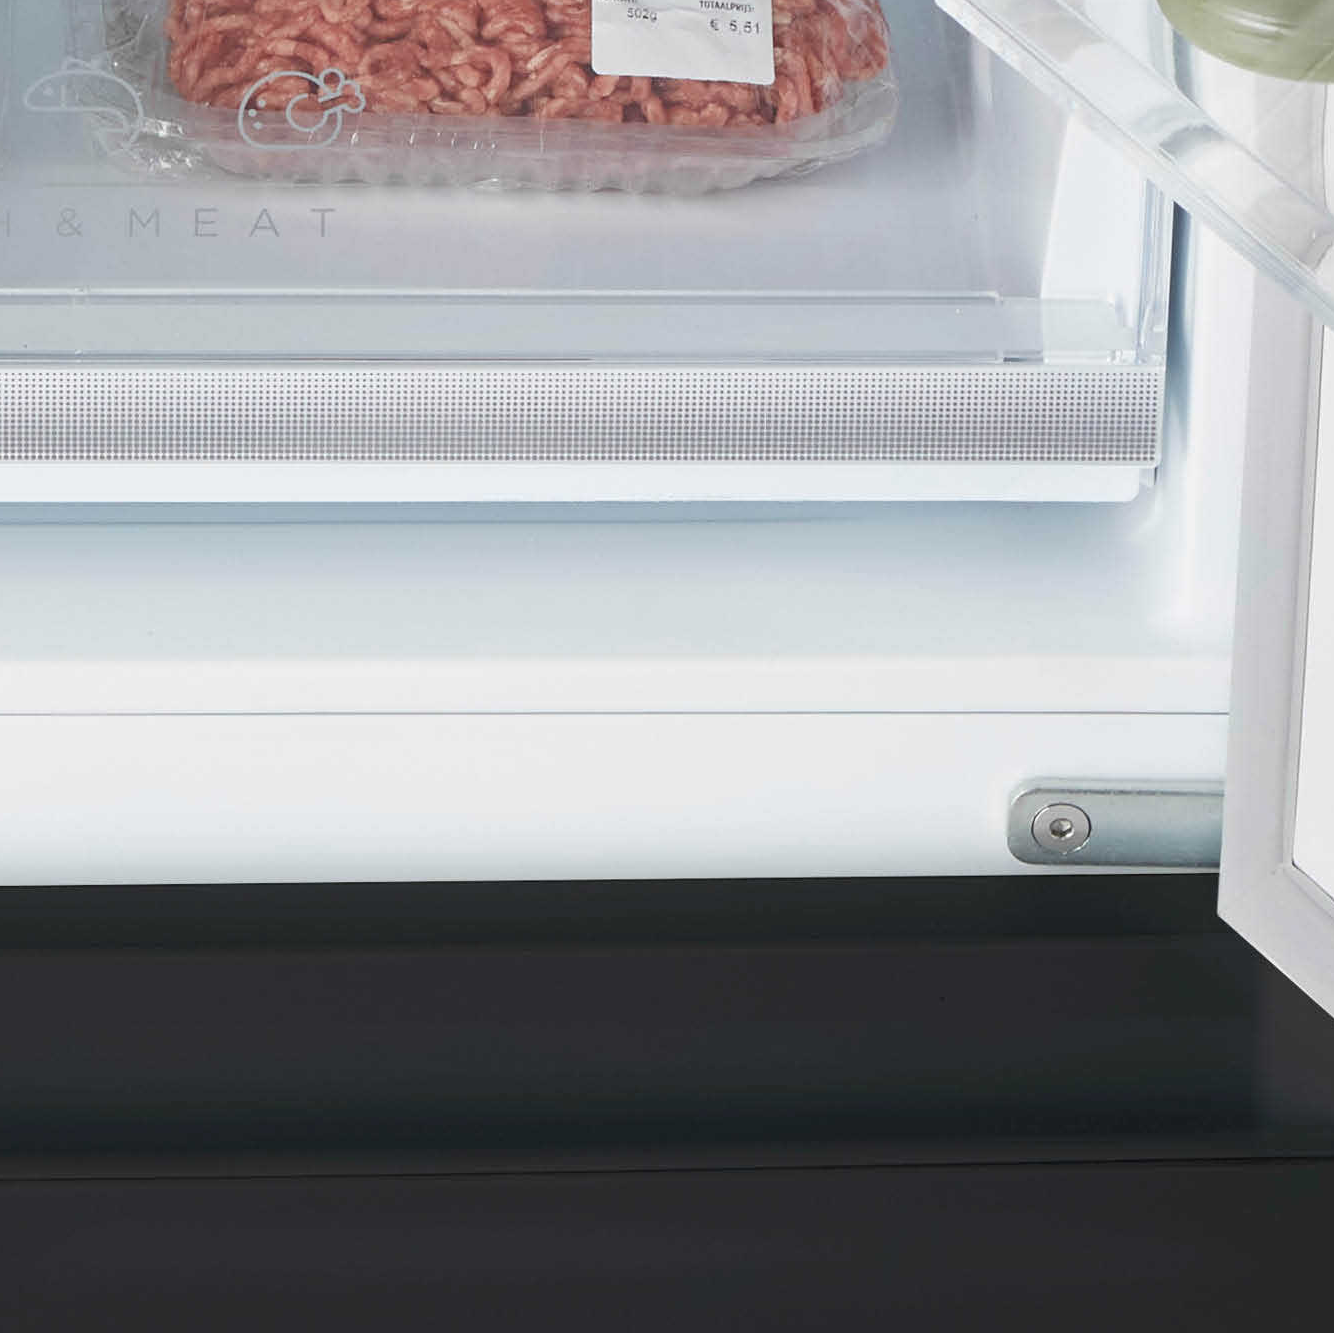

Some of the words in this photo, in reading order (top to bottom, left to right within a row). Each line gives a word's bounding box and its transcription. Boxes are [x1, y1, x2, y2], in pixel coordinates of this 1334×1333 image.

[710, 19, 720, 32] €
[57, 208, 83, 238] &
[129, 208, 337, 238] MEAT
